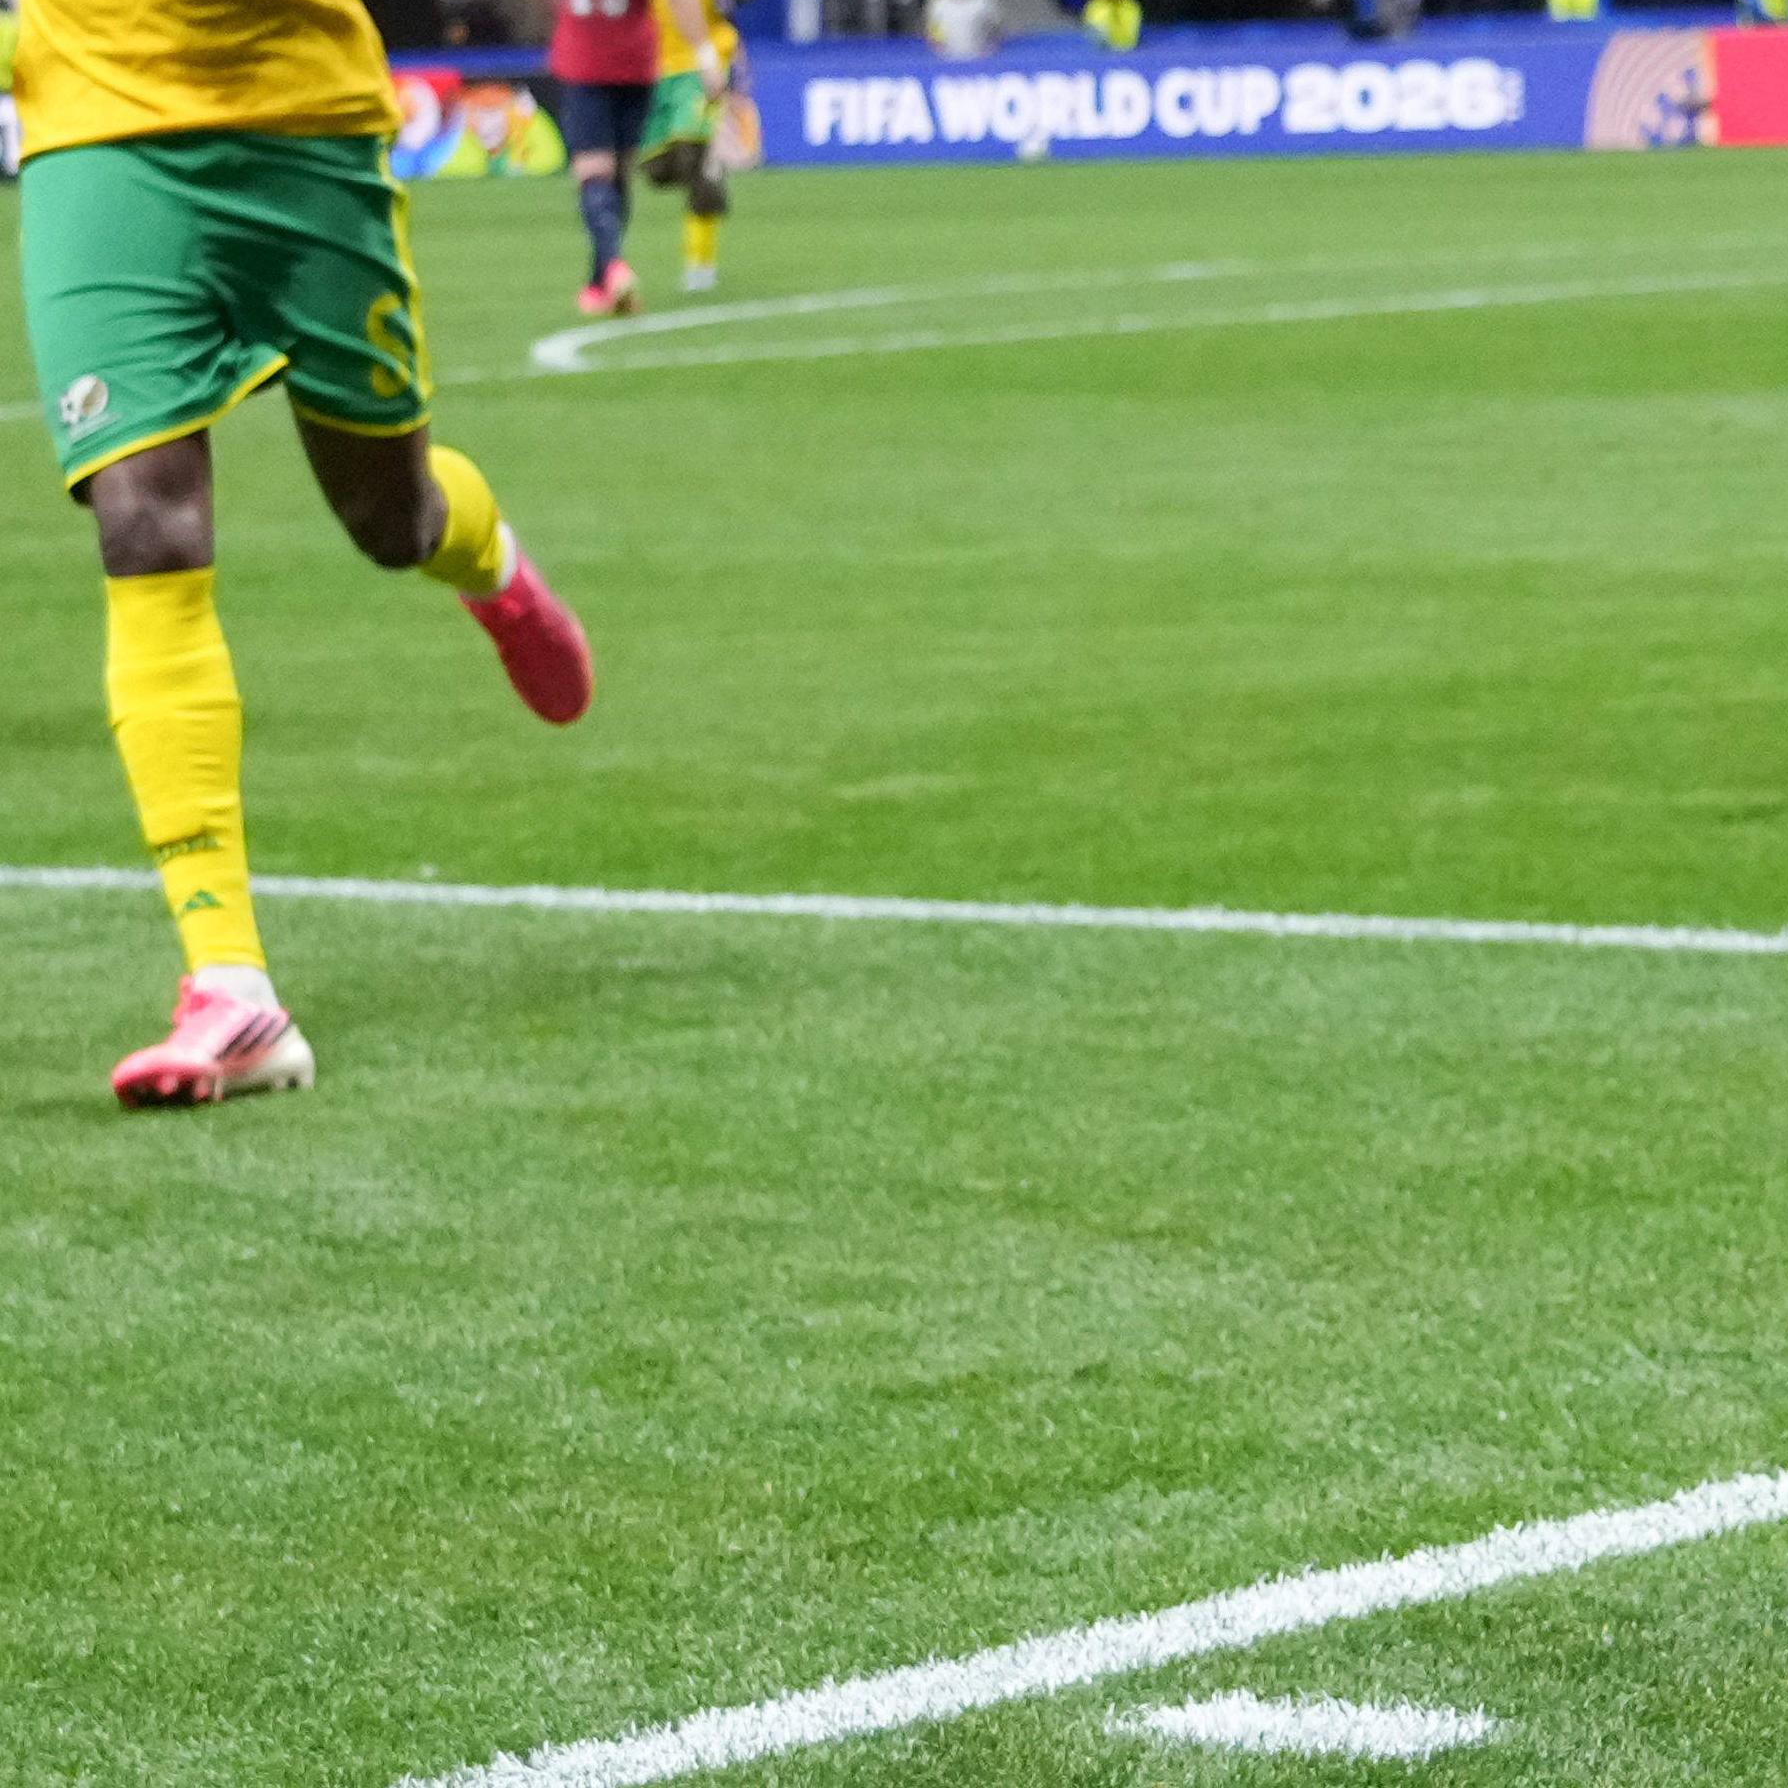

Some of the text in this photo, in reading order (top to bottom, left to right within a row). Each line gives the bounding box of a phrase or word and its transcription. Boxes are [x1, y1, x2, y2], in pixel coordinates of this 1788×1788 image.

[802, 75, 937, 147] FIFA
[929, 68, 1152, 146] WORLD
[1153, 64, 1282, 139] CUP
[1281, 56, 1505, 134] 2026
